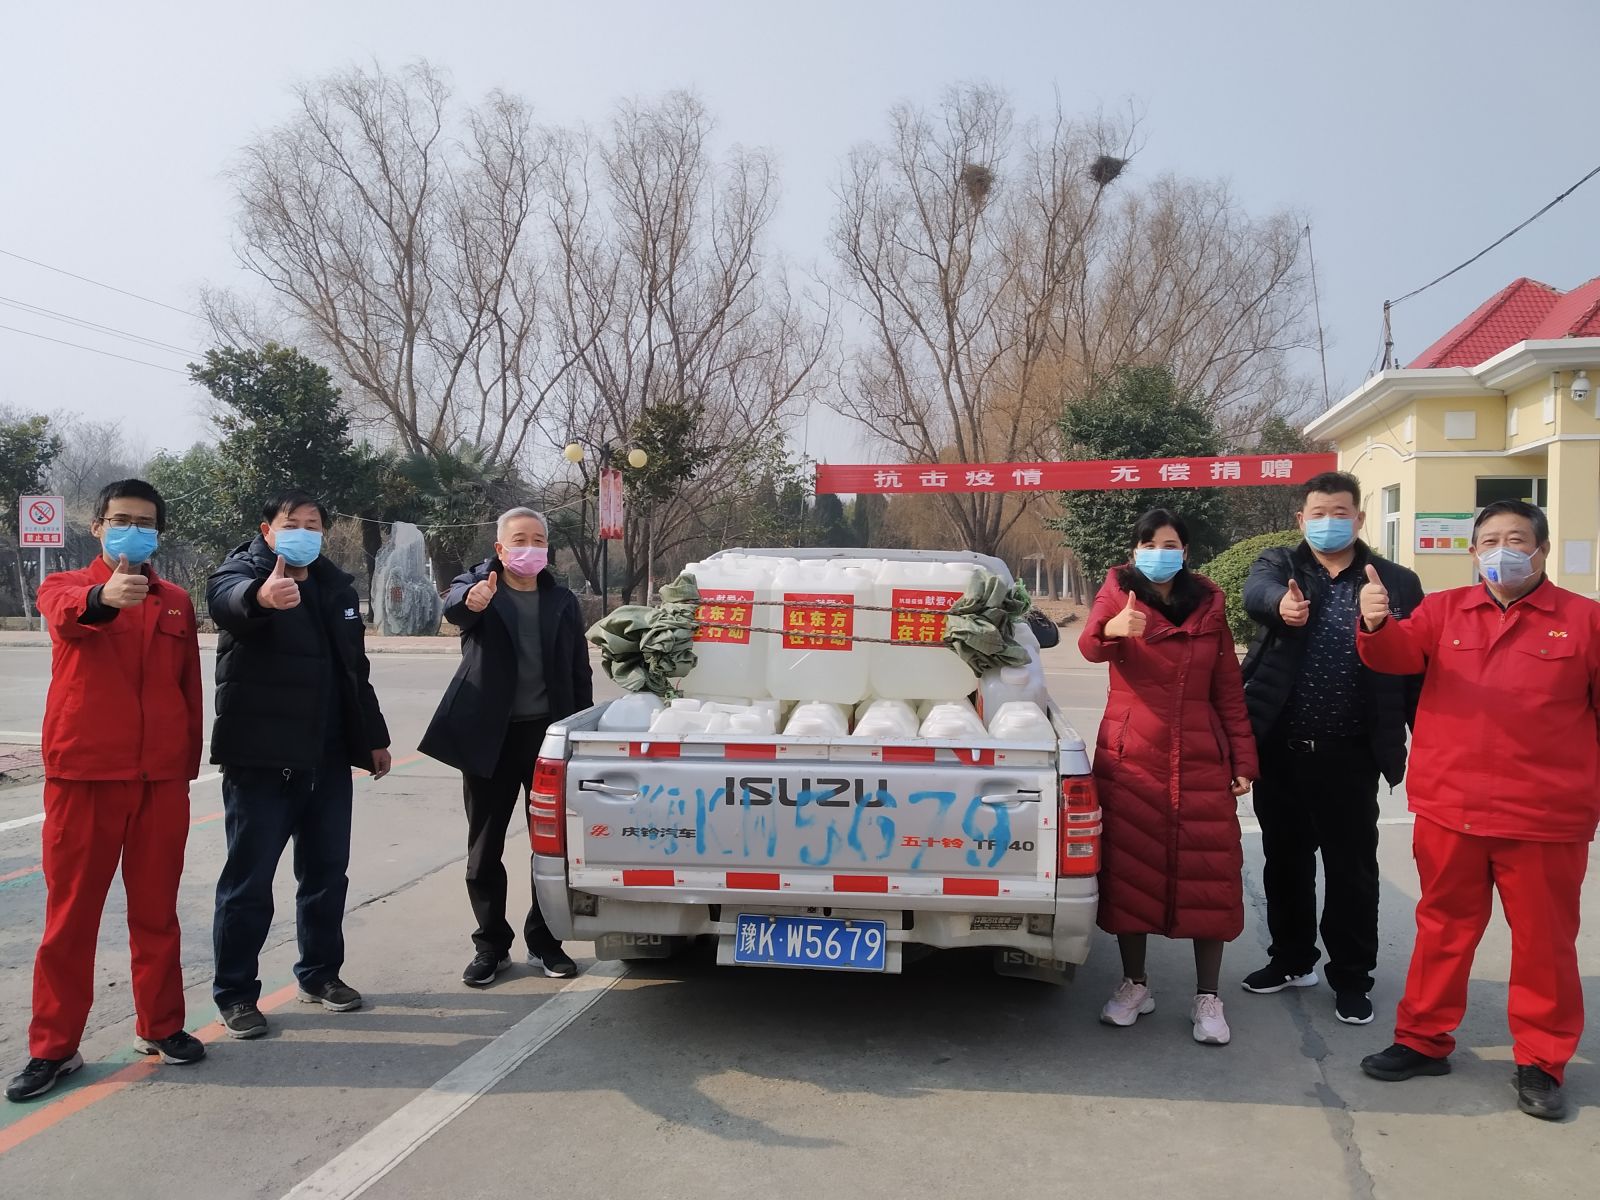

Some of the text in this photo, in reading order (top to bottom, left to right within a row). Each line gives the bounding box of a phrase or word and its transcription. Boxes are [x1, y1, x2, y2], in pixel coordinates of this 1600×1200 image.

[874, 459, 1293, 488] 抗击疫情 无偿捐赠
[789, 610, 847, 627] 红东方
[898, 607, 948, 624] 红东
[898, 625, 946, 641] 在行
[726, 777, 888, 807] ISUZU
[622, 827, 697, 839] 庆铃汽车
[901, 836, 964, 848] 五十铃
[973, 839, 1035, 852] TF40
